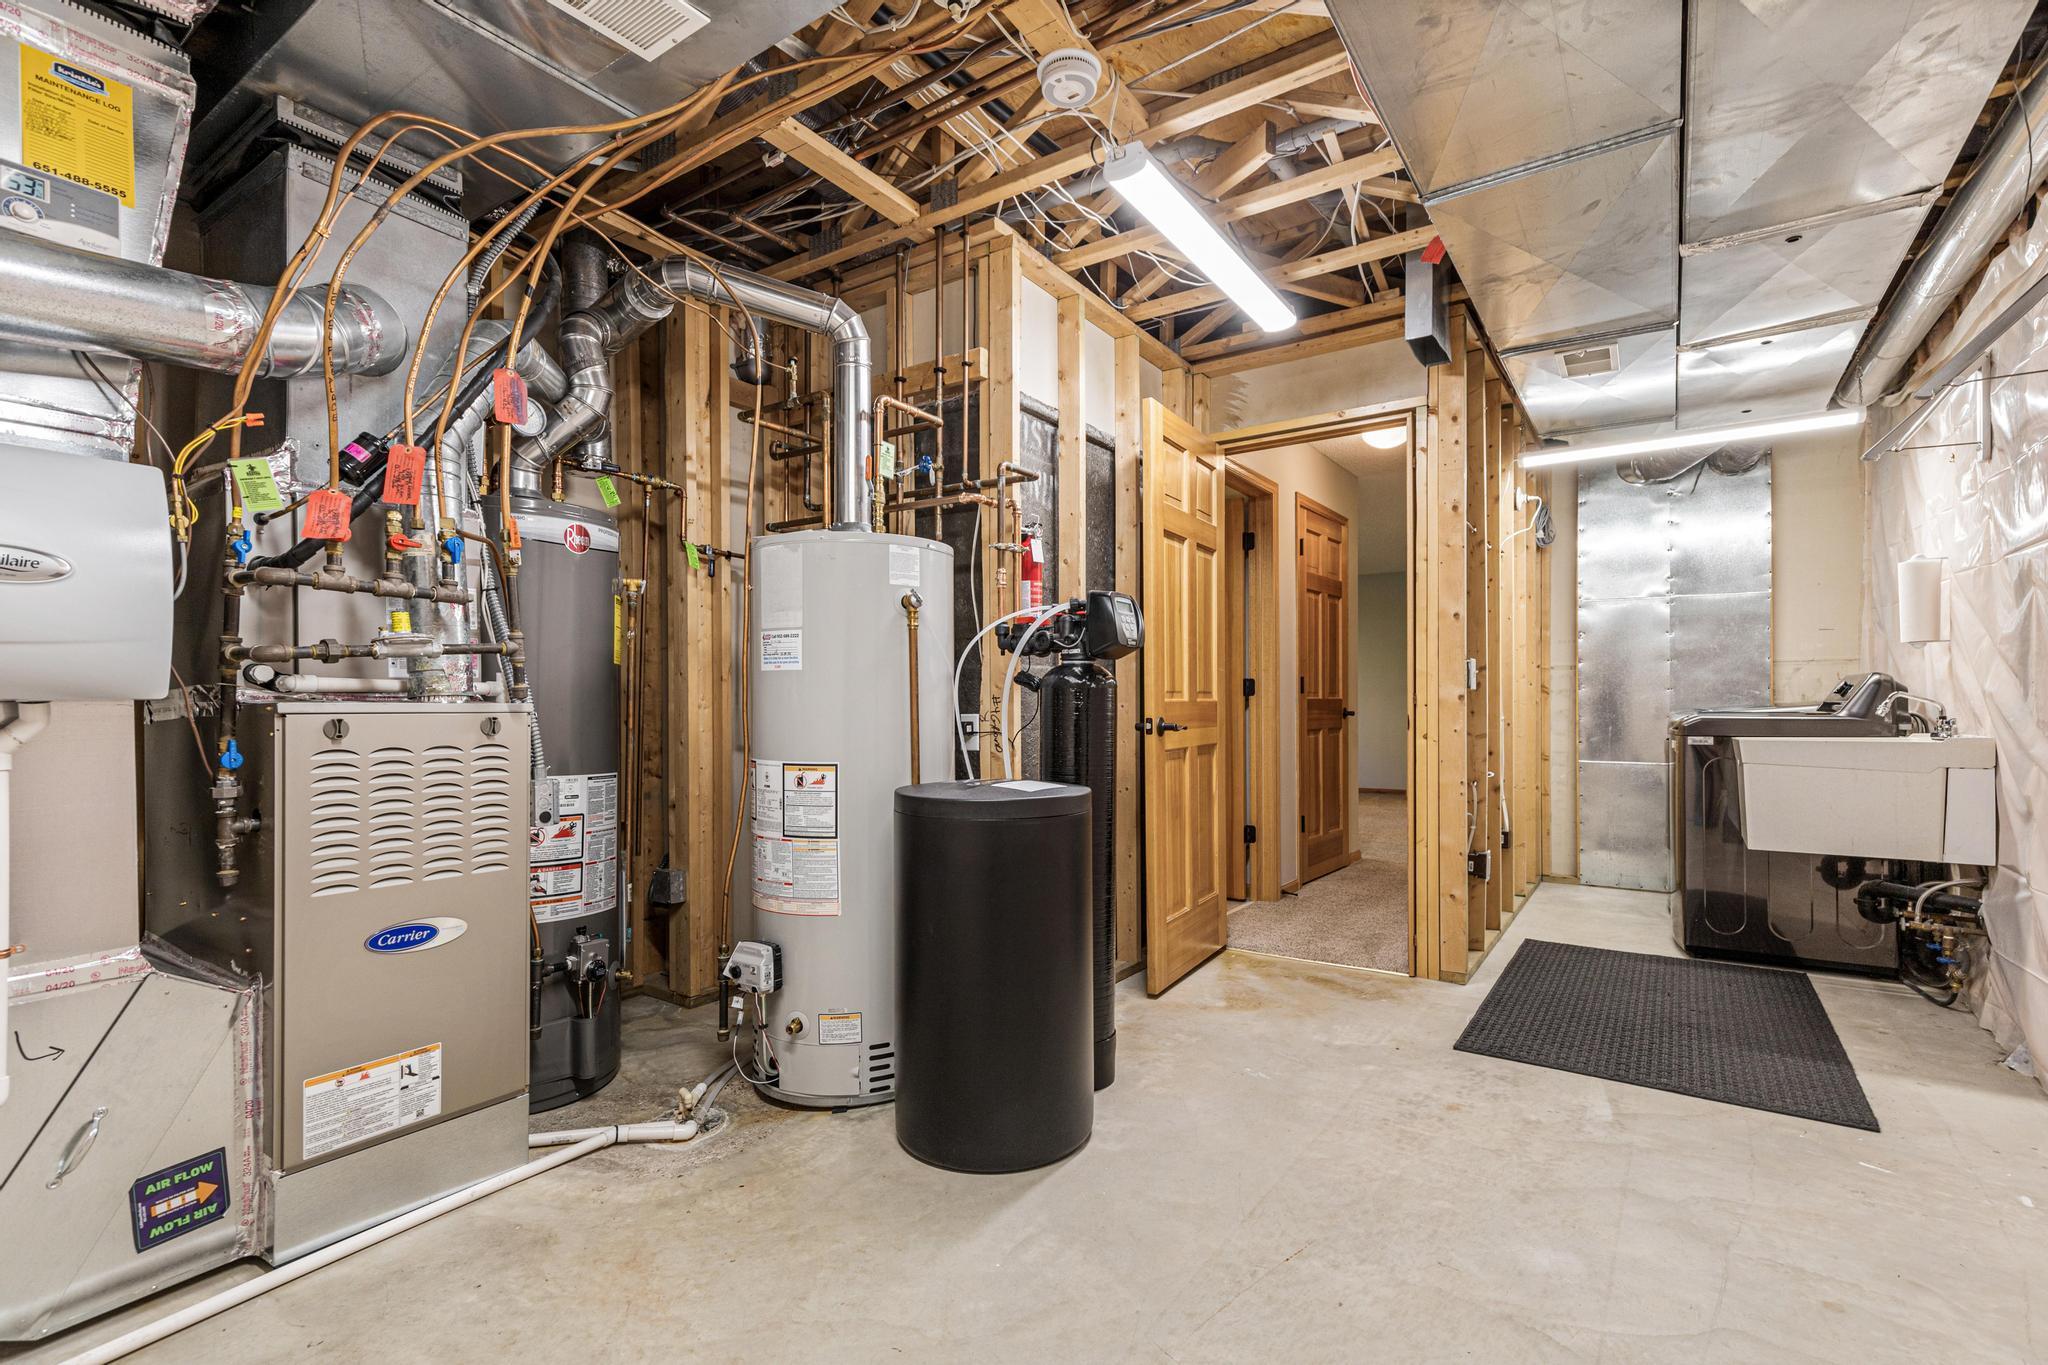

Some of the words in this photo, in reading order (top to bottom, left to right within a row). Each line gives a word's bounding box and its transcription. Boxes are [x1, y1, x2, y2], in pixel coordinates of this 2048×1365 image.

[35, 75, 100, 105] MAINTENANCE
[103, 101, 121, 113] LOG
[33, 161, 127, 199] 651-488-5555
[0, 553, 40, 569] ilaire
[378, 929, 430, 947] Carrier
[45, 980, 76, 992] 04/20
[145, 1179, 171, 1195] AIR
[174, 1161, 214, 1184] FLOW
[193, 1202, 218, 1220] AIR
[149, 1214, 191, 1239] FLOW
